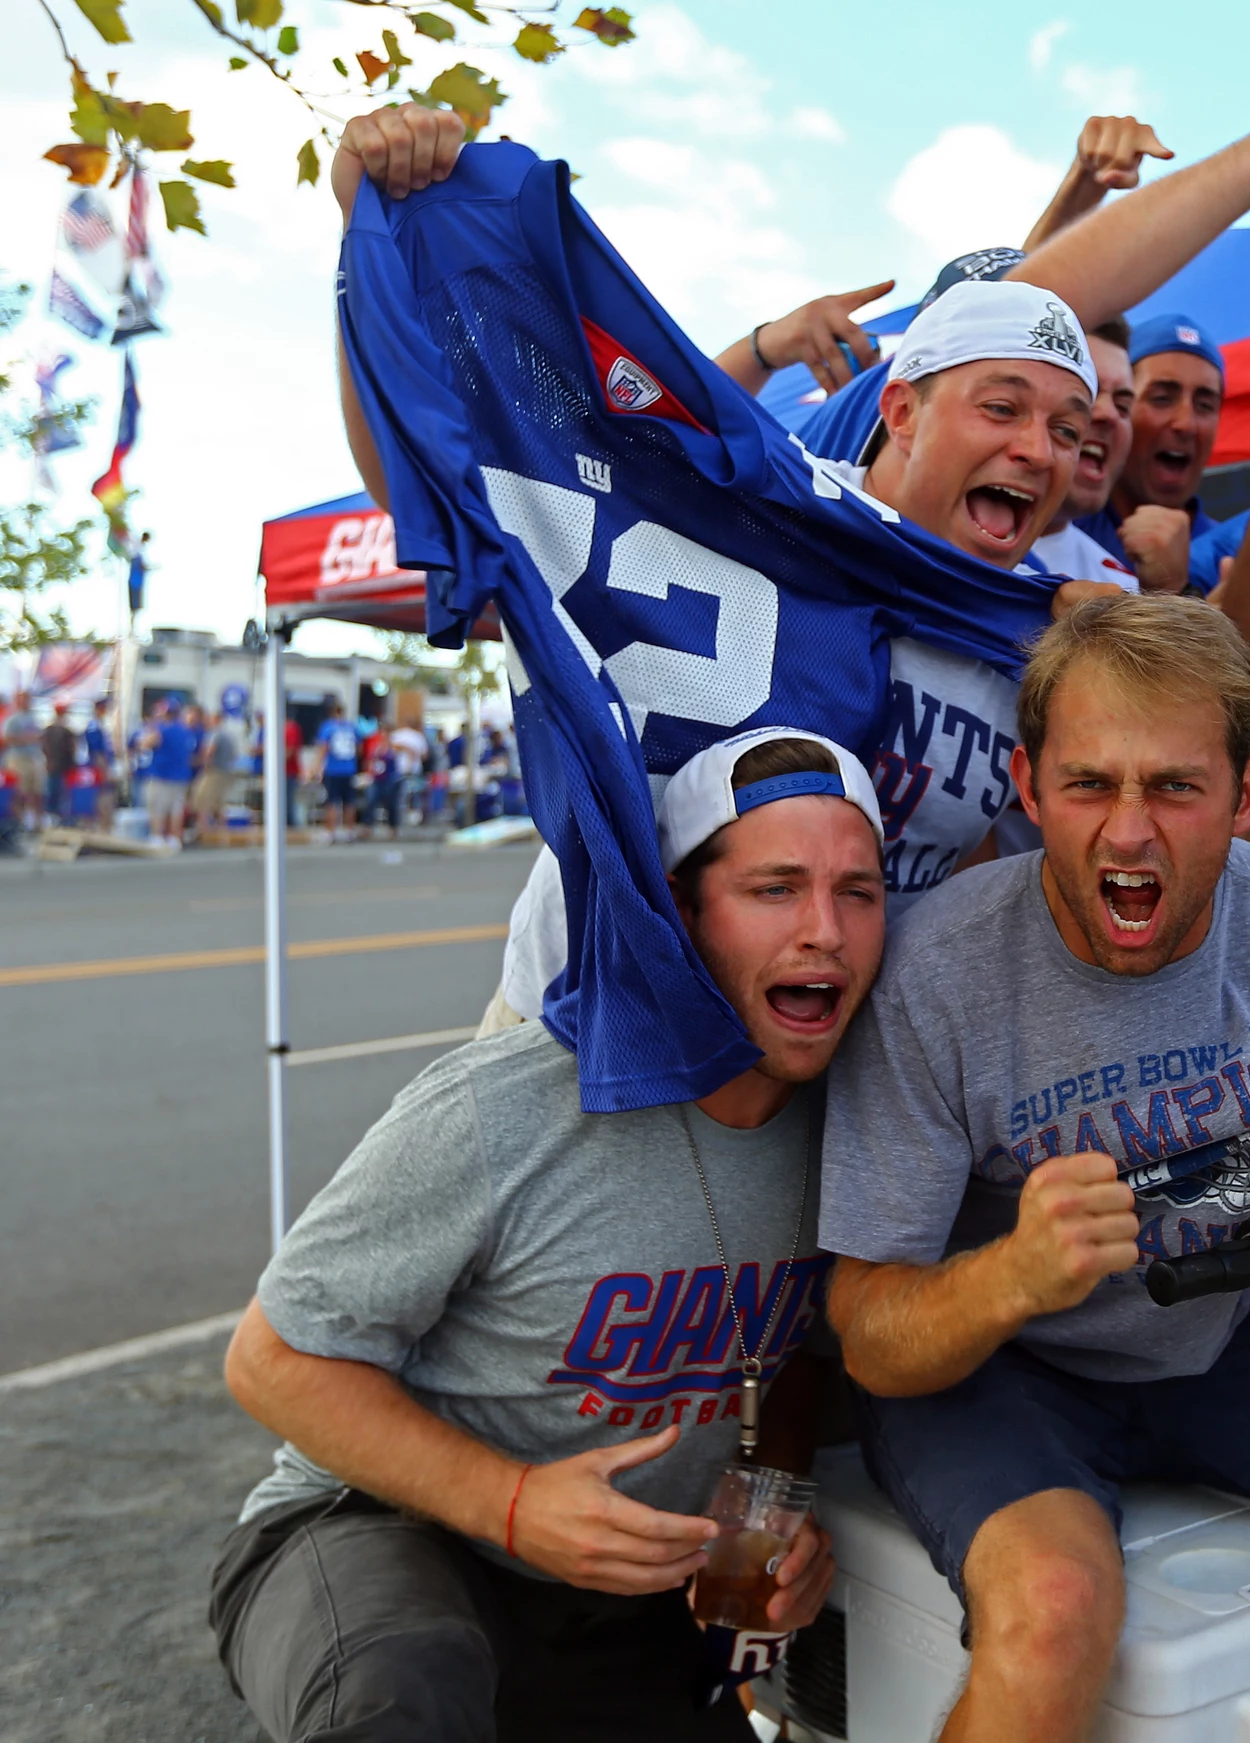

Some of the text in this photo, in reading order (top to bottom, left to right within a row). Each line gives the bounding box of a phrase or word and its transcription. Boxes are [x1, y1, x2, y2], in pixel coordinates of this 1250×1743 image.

[1027, 330, 1083, 367] XLVI
[620, 361, 655, 396] EQUIPMENT
[1010, 1062, 1127, 1141] SUPER
[1139, 1041, 1243, 1088] BOWL
[577, 1391, 742, 1430] FOOTBA
